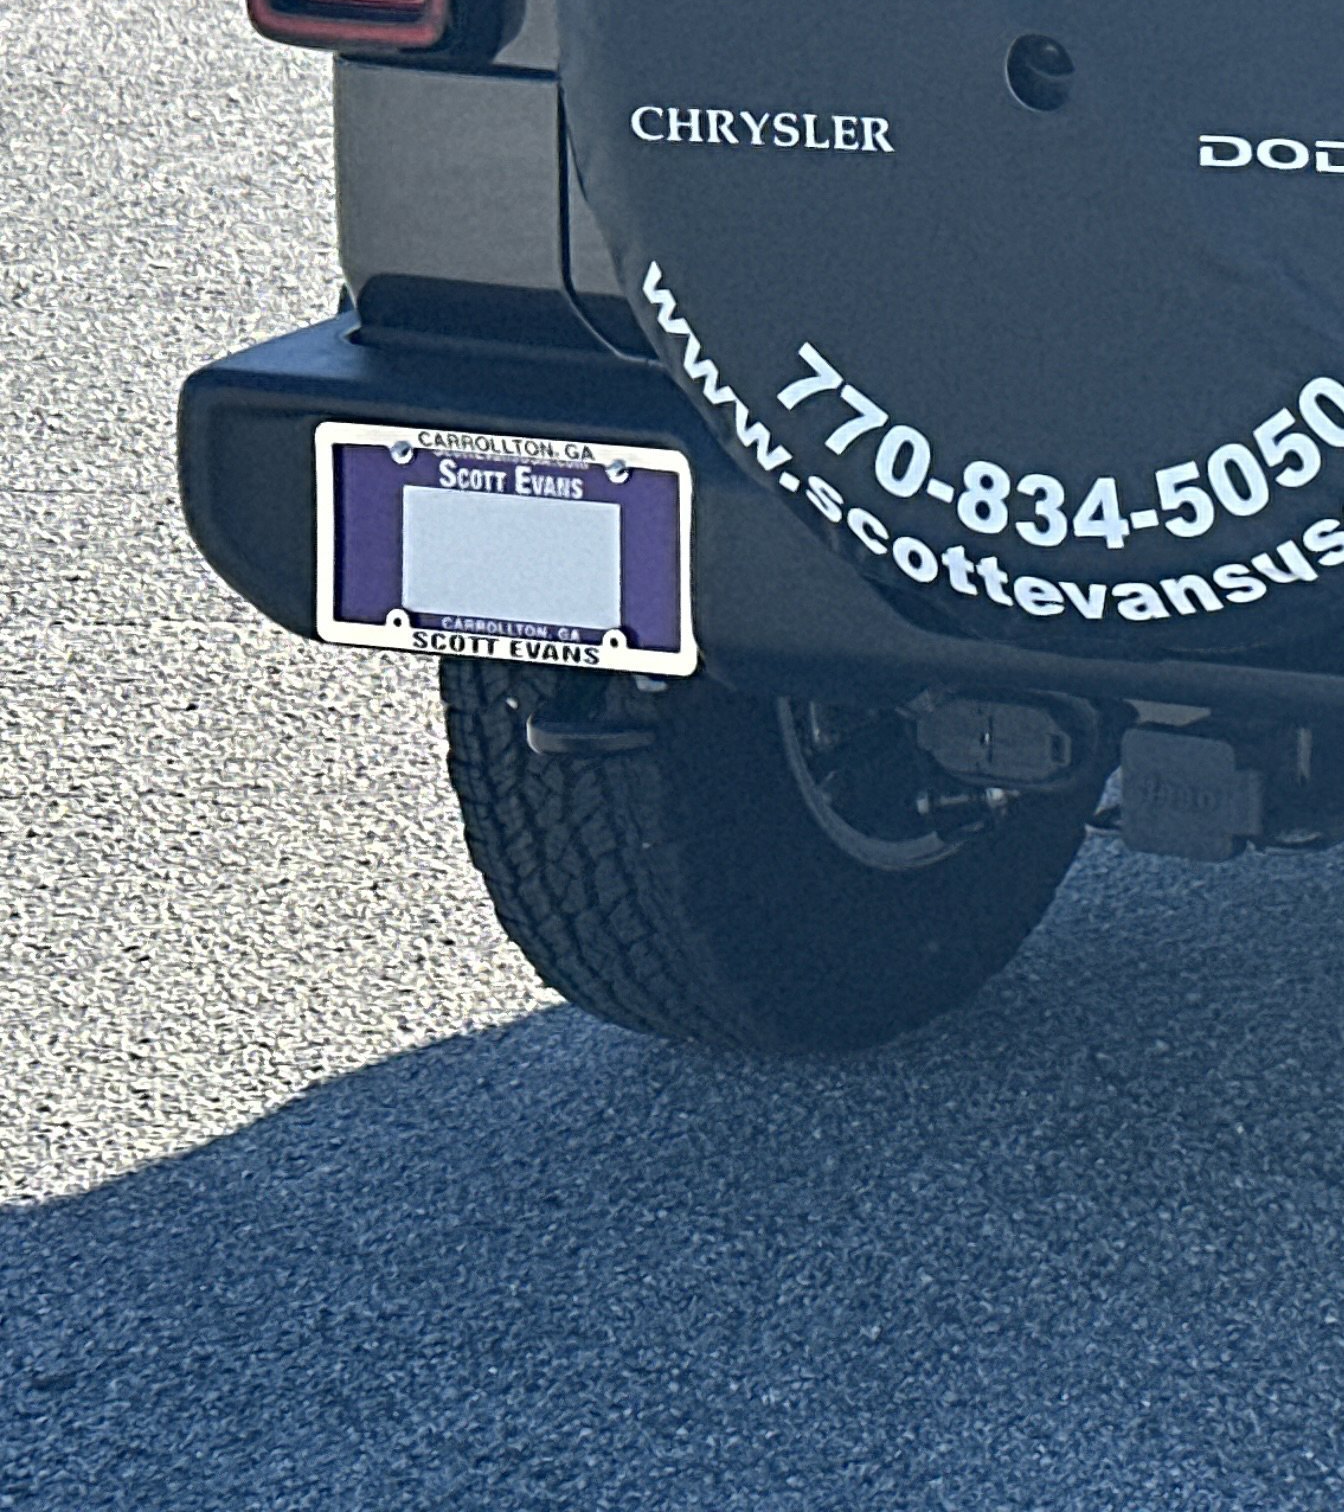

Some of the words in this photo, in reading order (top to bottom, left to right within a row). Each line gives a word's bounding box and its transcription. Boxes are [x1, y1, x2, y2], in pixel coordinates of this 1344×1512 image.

[630, 105, 895, 154] CHRYSLER
[564, 443, 596, 461] GA
[412, 631, 500, 656] SCOTT
[510, 640, 600, 665] EVANS
[558, 628, 580, 642] GA
